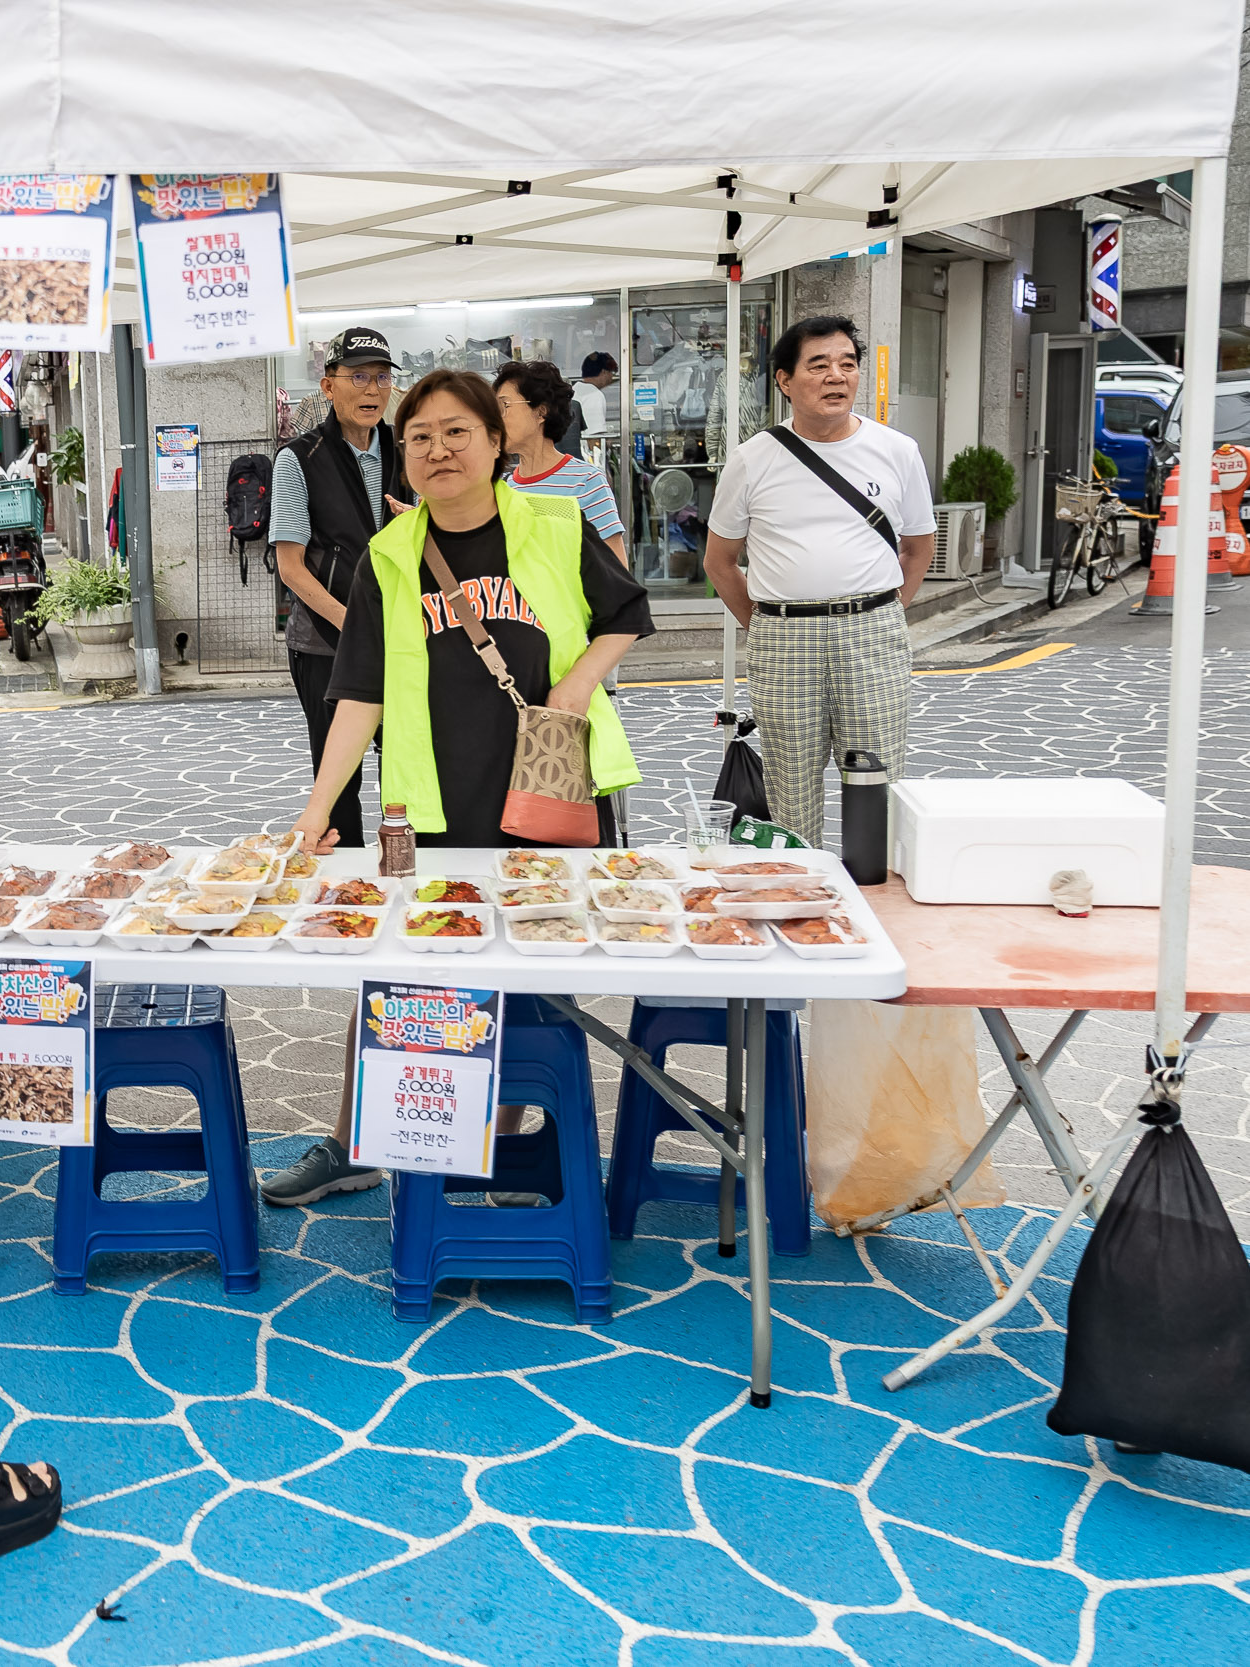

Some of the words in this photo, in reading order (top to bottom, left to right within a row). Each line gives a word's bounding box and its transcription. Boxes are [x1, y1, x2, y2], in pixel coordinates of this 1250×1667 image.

[184, 249, 245, 268] 5,000원
[187, 282, 248, 302] 5,000원
[384, 999, 465, 1022] 아차산의
[34, 1054, 73, 1066] 5,000원
[398, 1078, 456, 1098] 5,000원
[395, 1107, 453, 1126] 5,000원
